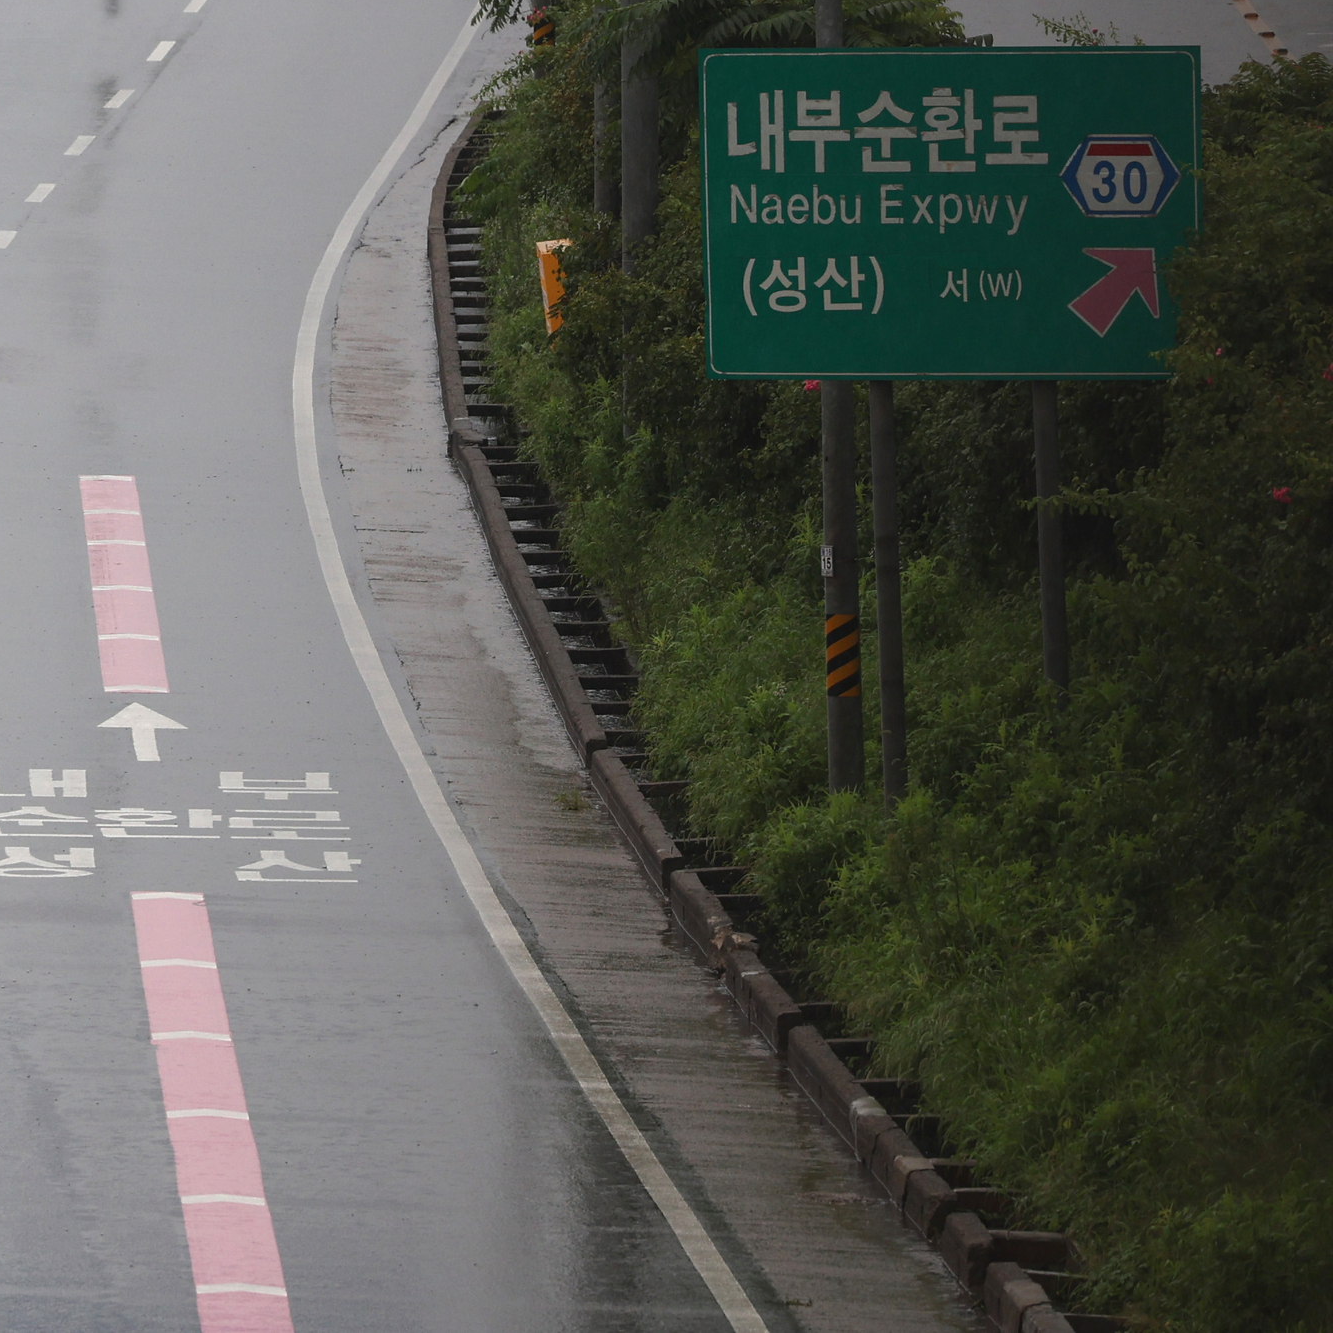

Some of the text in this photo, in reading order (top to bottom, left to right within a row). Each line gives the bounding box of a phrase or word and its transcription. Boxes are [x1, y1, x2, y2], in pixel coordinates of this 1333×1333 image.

[726, 87, 1049, 174] 내부순환로
[1091, 160, 1148, 204] 30
[730, 184, 1029, 236] Naebu Expwy
[742, 256, 885, 317] (성산)
[823, 557, 832, 570] 15
